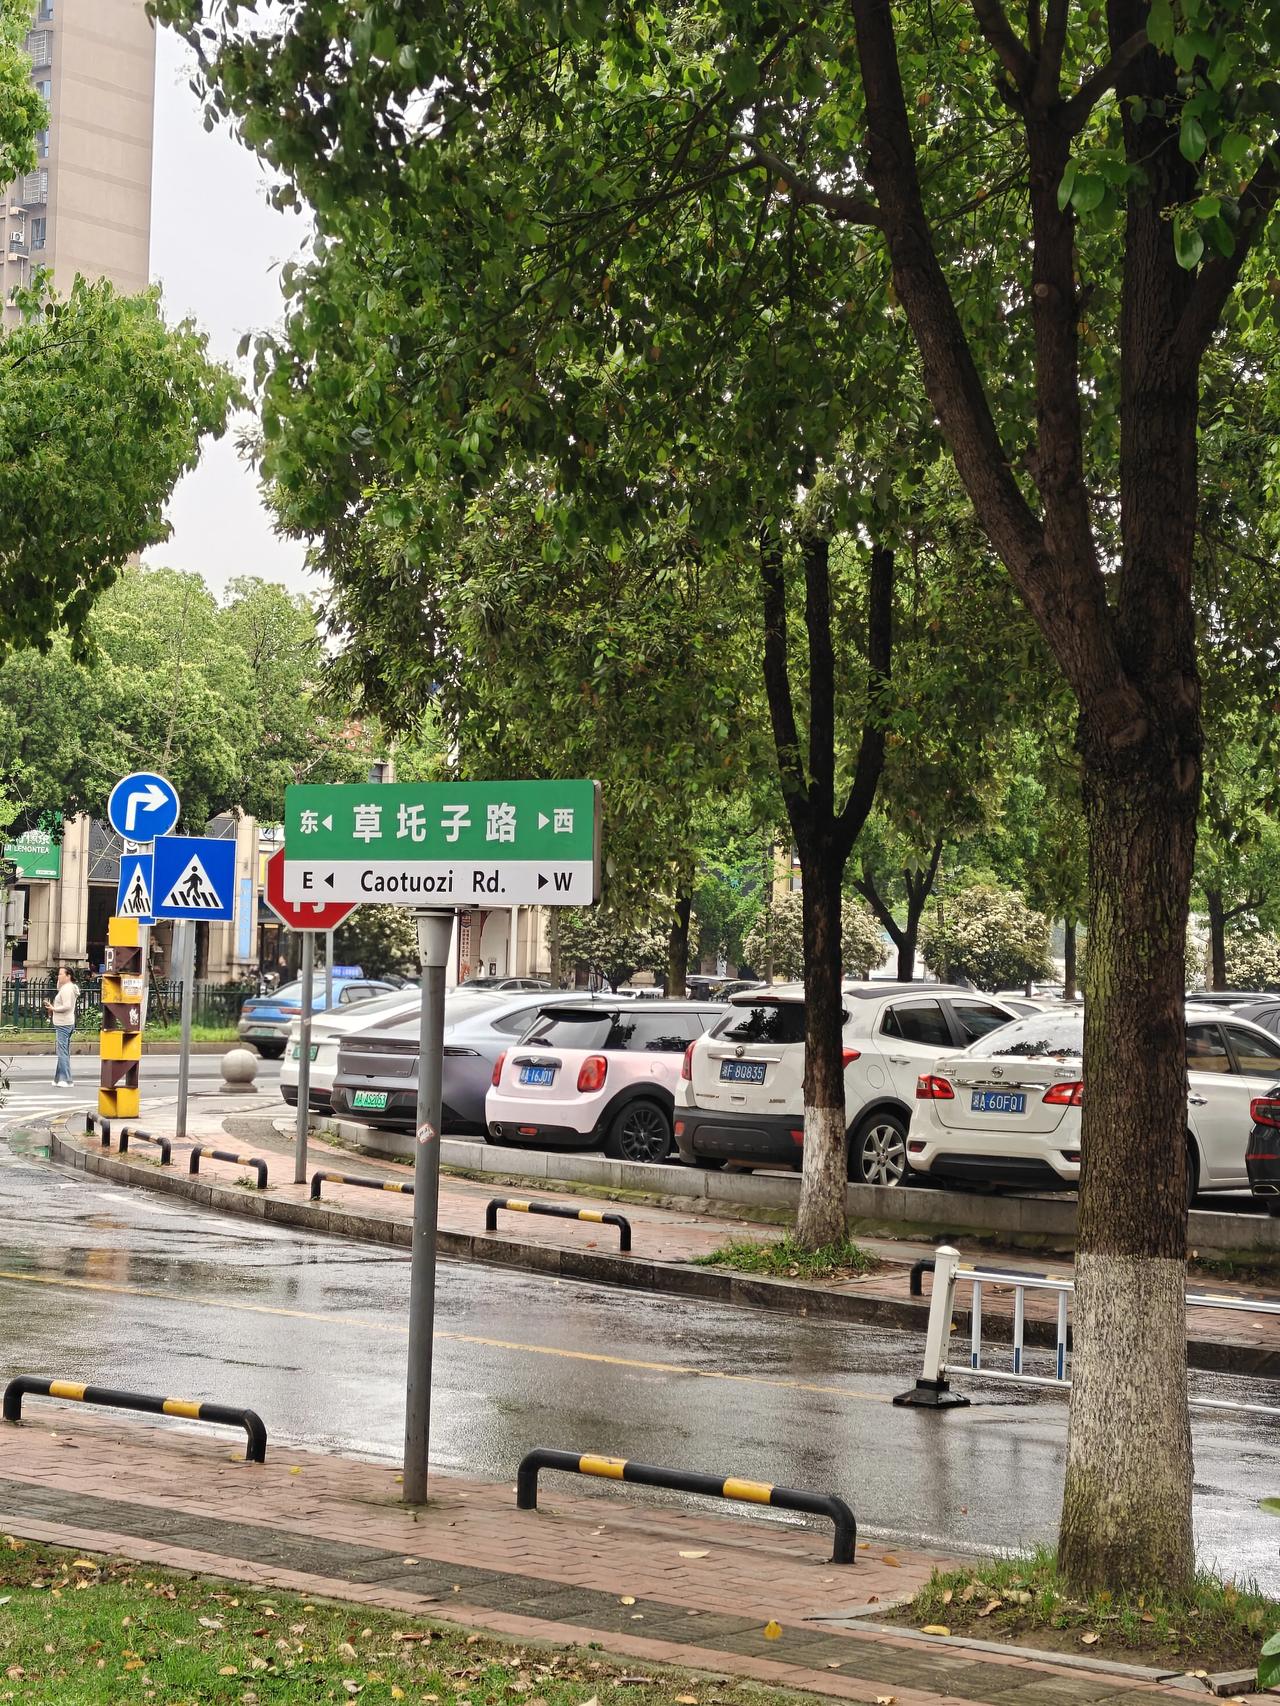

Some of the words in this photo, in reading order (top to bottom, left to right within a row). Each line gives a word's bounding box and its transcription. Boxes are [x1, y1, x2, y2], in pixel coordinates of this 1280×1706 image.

[300, 809, 318, 834] 东
[553, 808, 574, 834] 西
[303, 871, 313, 889] E
[361, 869, 453, 893] Caotuozi
[472, 869, 506, 893] Rd.
[553, 872, 573, 892] W
